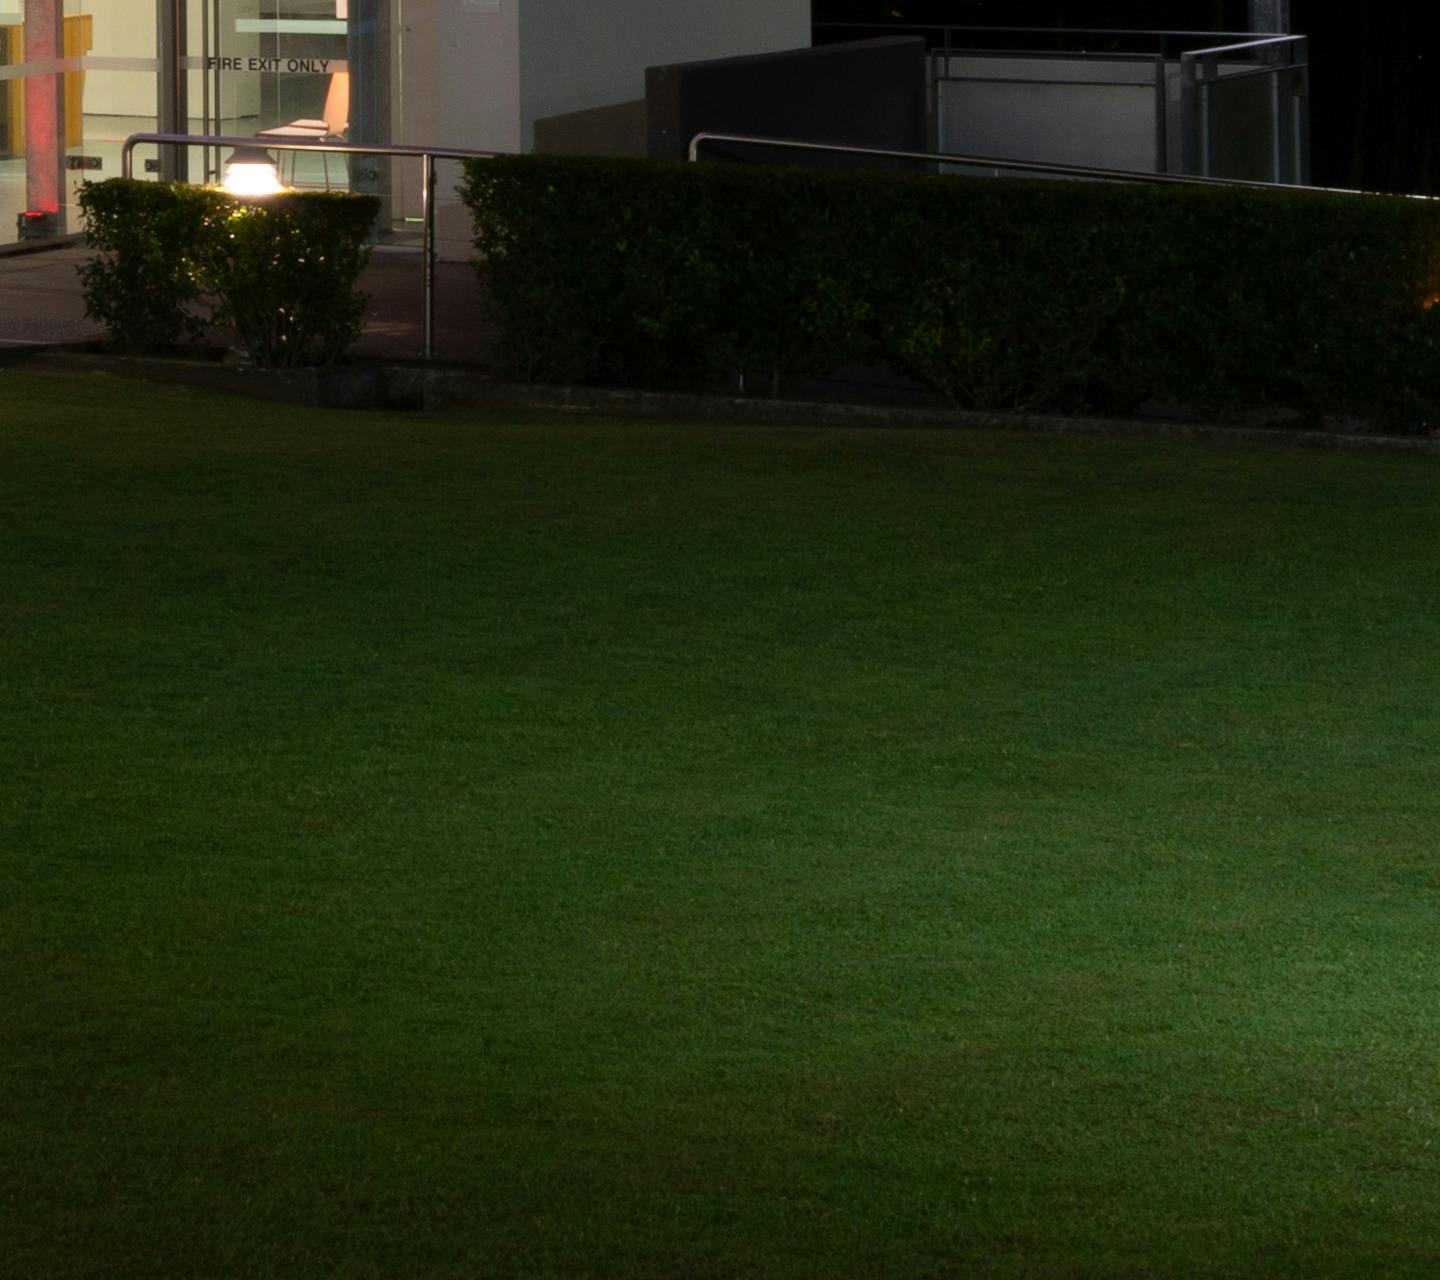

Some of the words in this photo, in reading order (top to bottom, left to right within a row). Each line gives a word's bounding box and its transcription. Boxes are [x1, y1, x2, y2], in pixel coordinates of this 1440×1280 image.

[207, 56, 243, 71] FIRE
[248, 57, 281, 72] EXIT
[287, 58, 330, 73] ONLY
